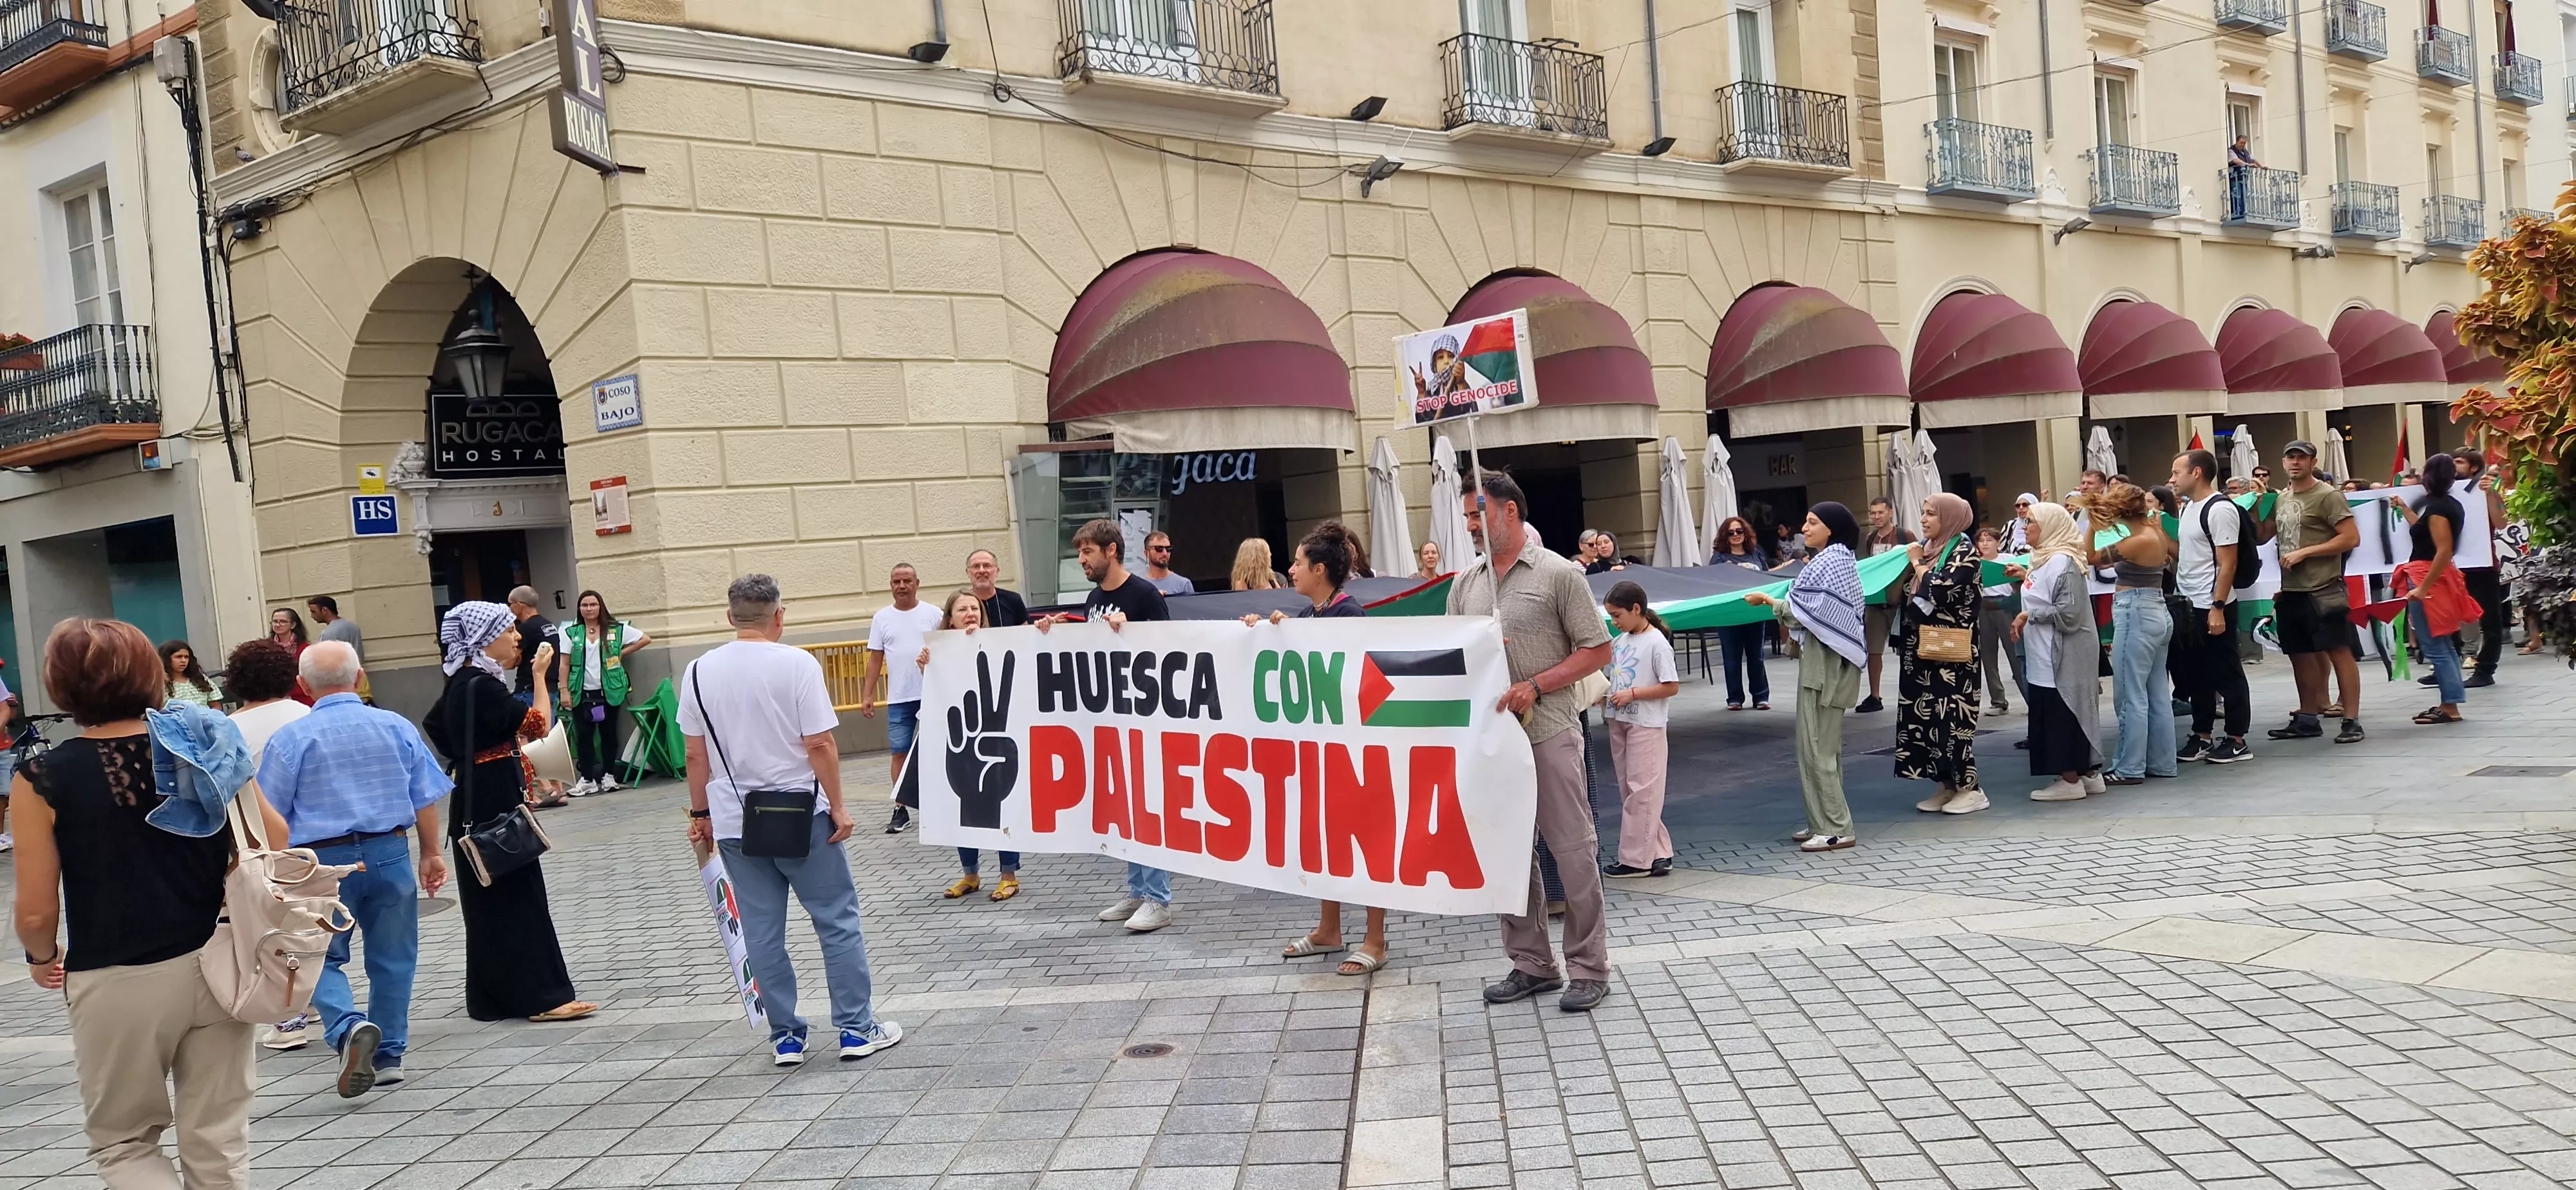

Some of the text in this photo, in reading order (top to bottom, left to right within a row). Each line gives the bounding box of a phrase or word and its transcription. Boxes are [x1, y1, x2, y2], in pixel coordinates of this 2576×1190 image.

[564, 96, 611, 162] RUGACA
[608, 386, 630, 398] COSO
[1416, 382, 1517, 413] STOP GENOCIDE
[601, 407, 634, 420] BAJO
[442, 420, 562, 444] RUGACA
[442, 449, 564, 462] HOSTAL
[1769, 455, 1796, 475] BAR
[357, 500, 392, 520] HS
[1036, 649, 1345, 725] HUESCA CON
[1030, 725, 1484, 889] PALESTINA
